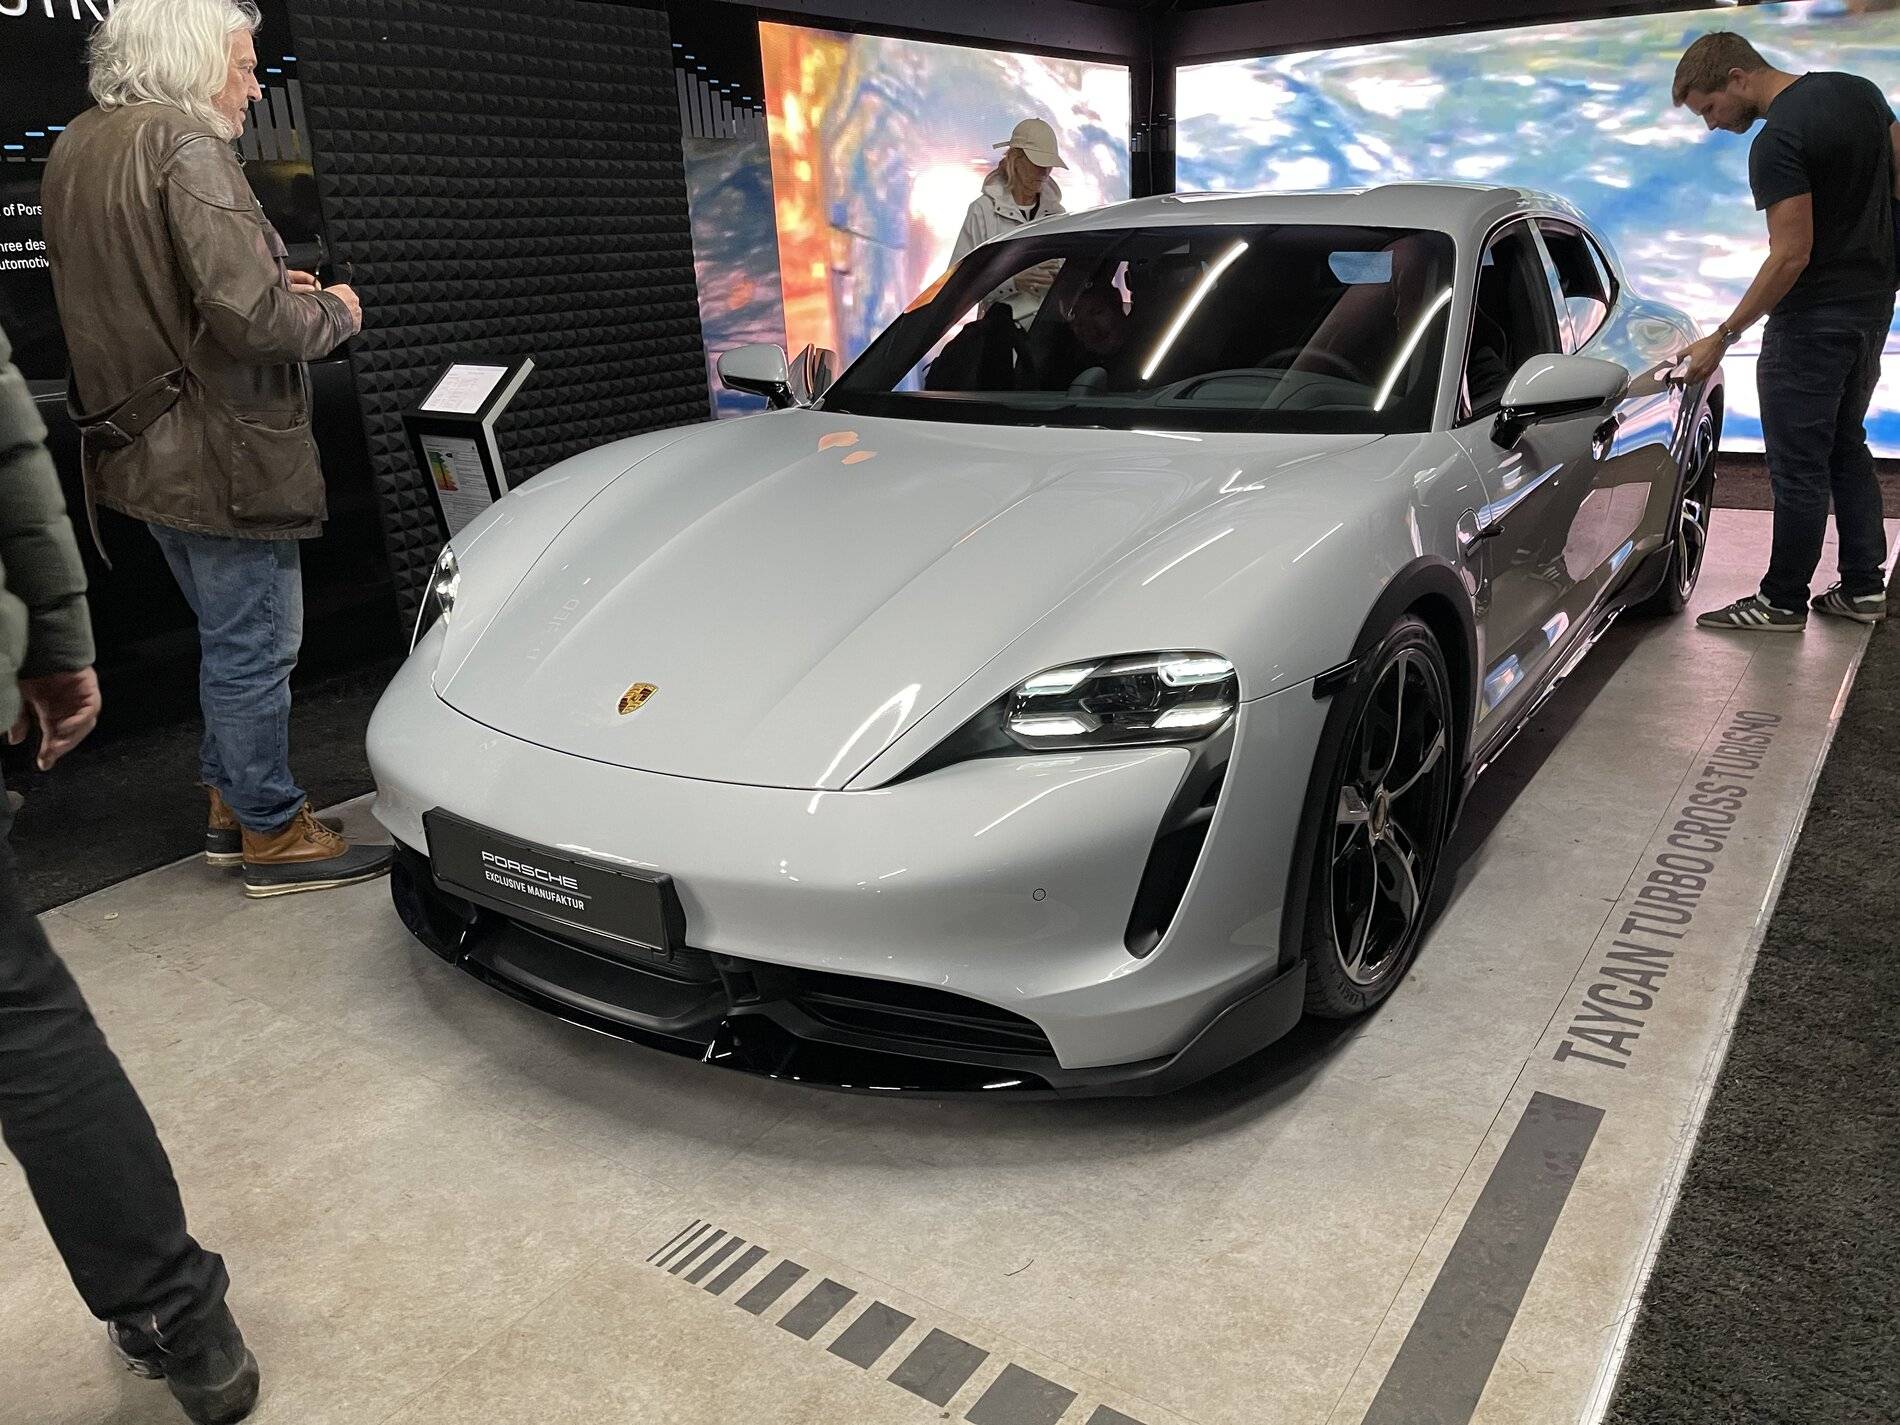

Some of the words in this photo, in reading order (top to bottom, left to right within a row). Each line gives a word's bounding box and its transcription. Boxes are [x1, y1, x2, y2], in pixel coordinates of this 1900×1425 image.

[3, 204, 15, 216] of
[1702, 710, 1782, 779] TURISMO
[1666, 781, 1748, 853] CROSS
[481, 851, 578, 889] PORSCHE
[485, 870, 526, 893] EXCLUSIVE
[527, 884, 585, 910] MANUFAKTUR
[1619, 853, 1715, 939] TURBO
[1552, 940, 1675, 1070] TAYCAN
